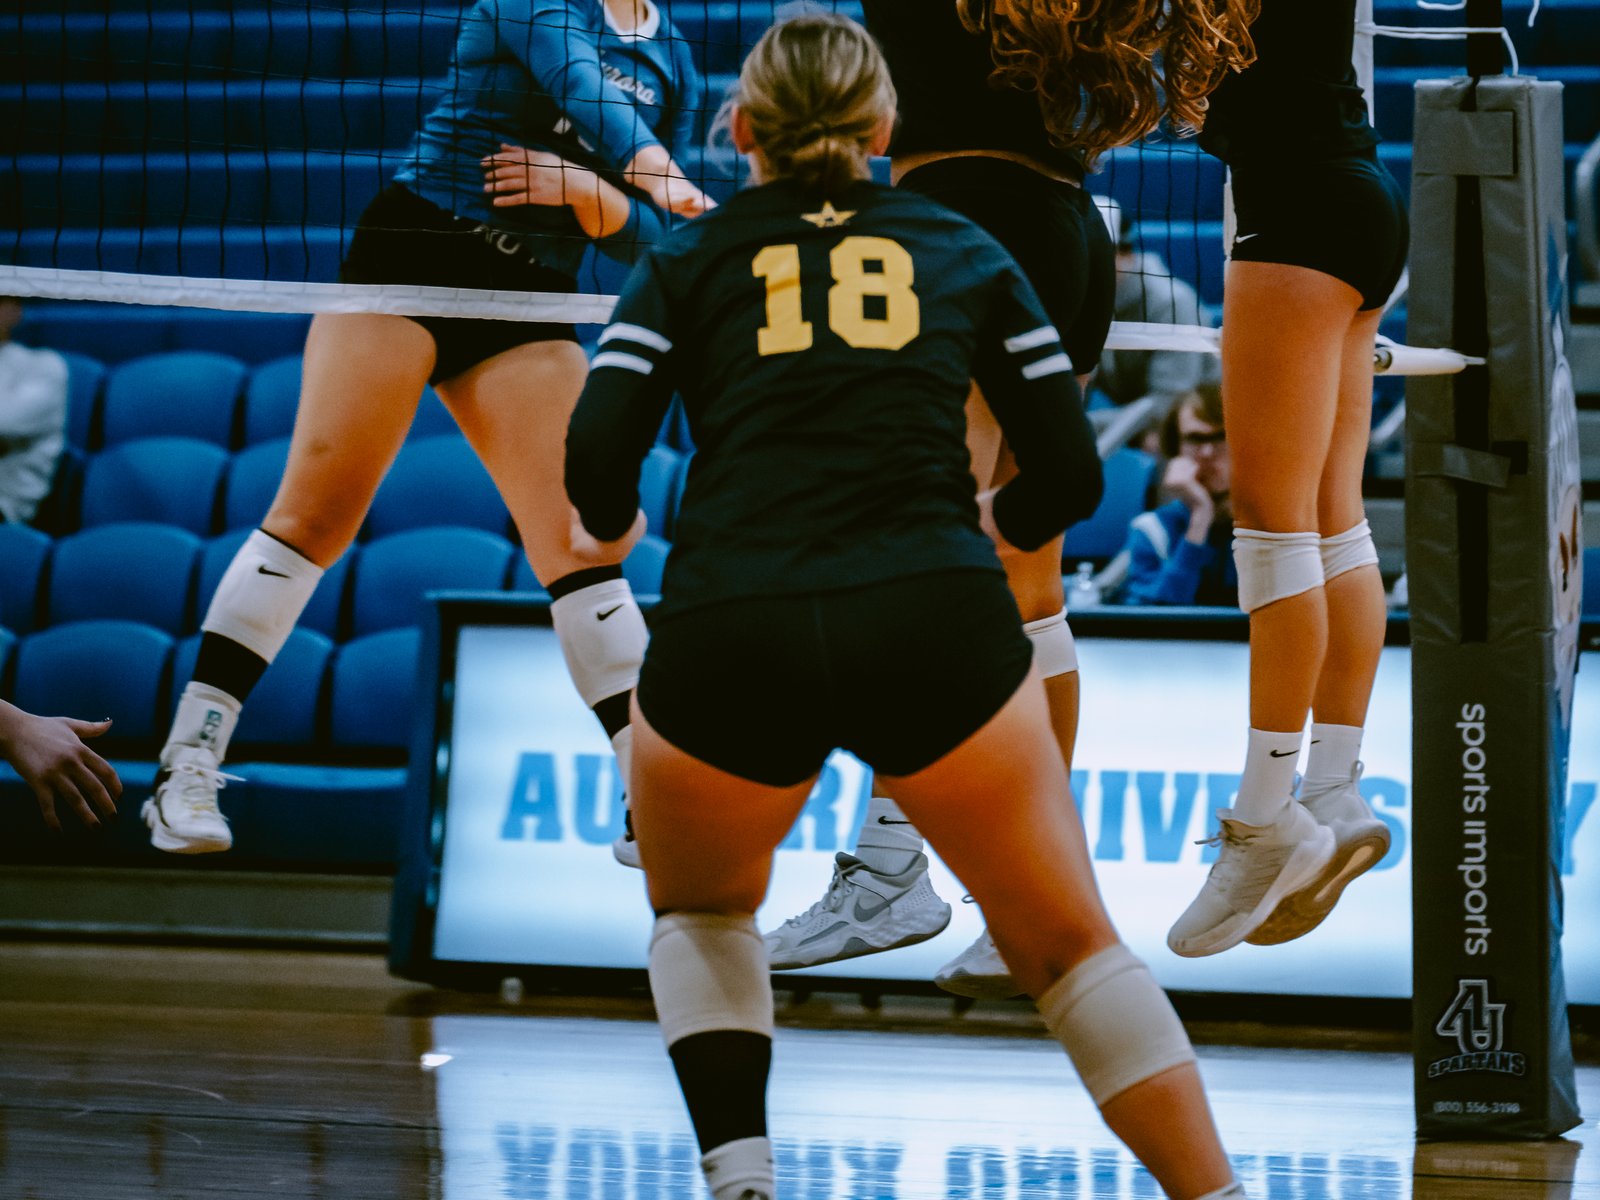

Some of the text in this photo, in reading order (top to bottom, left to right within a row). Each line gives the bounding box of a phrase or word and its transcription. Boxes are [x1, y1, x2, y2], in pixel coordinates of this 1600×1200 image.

[601, 50, 656, 106] urora
[752, 236, 921, 356] 18
[1456, 703, 1492, 955] sports imports
